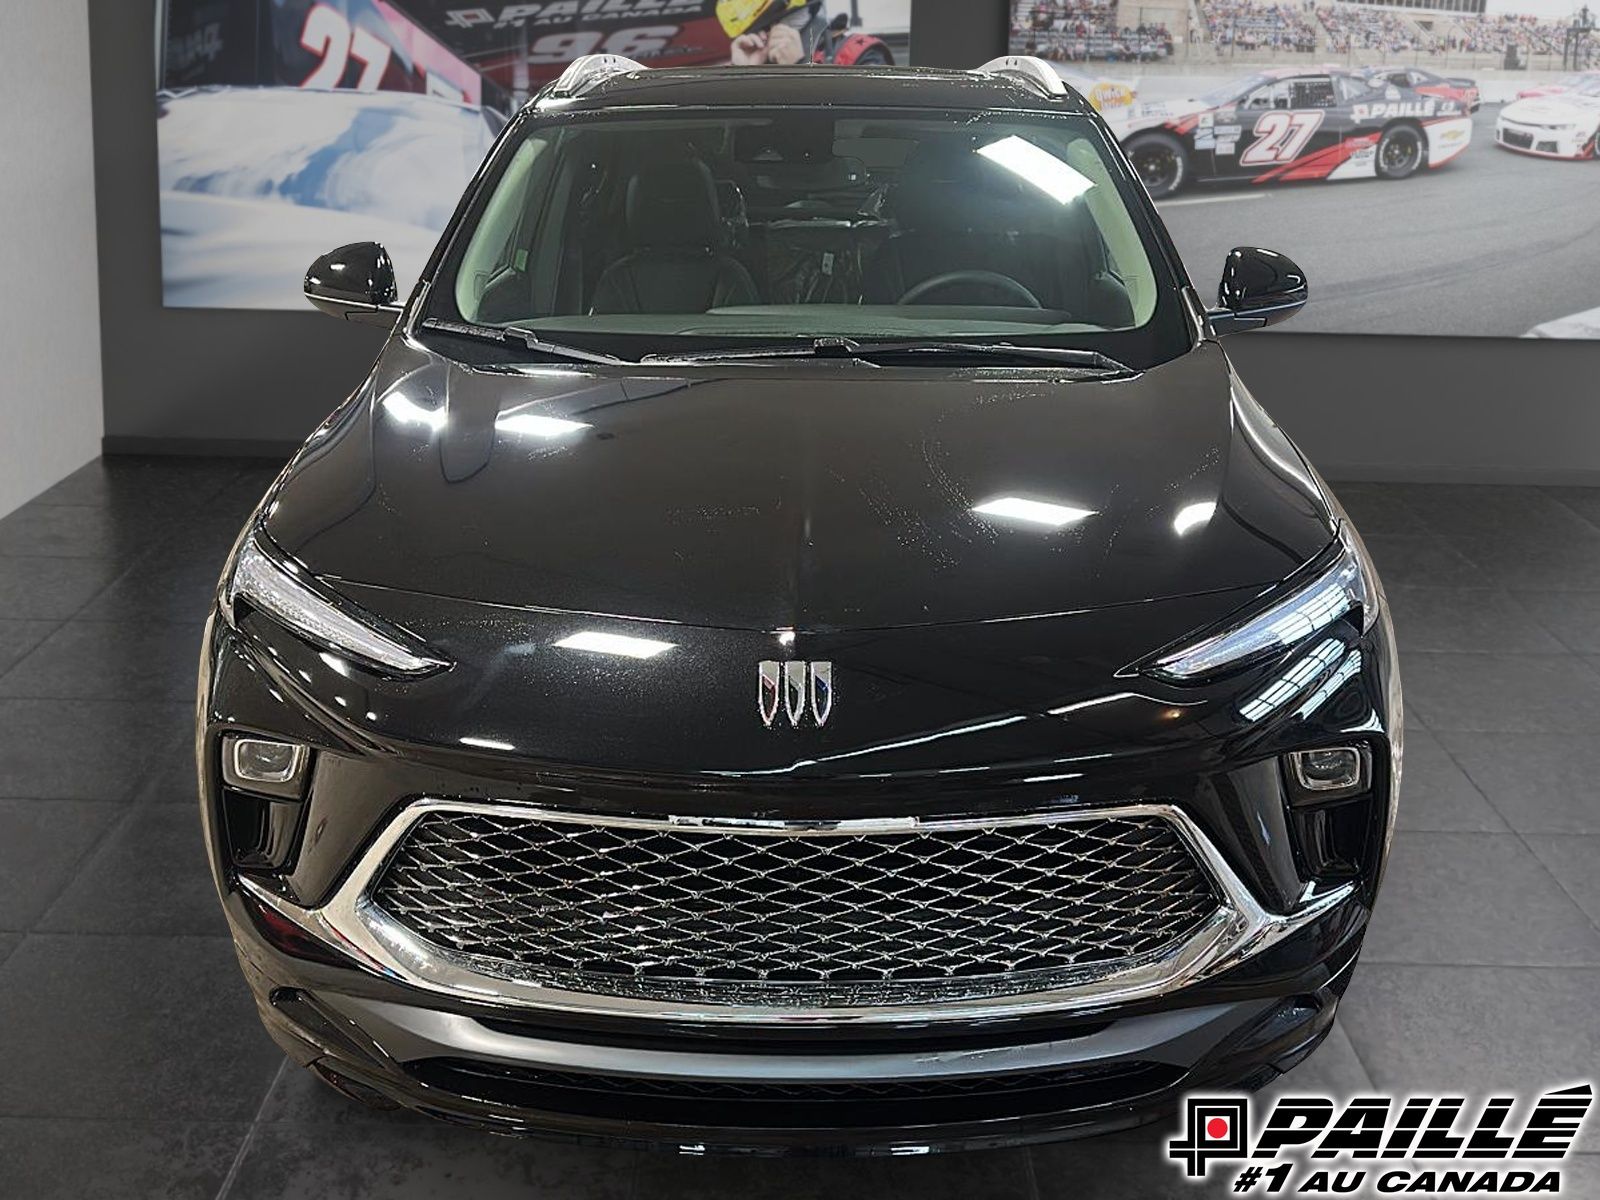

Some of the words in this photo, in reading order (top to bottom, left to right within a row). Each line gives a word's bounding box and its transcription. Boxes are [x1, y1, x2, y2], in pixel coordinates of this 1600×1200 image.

[581, 5, 703, 22] CANADA
[300, 2, 392, 91] 27
[528, 25, 679, 64] 96
[1239, 109, 1326, 167] 27
